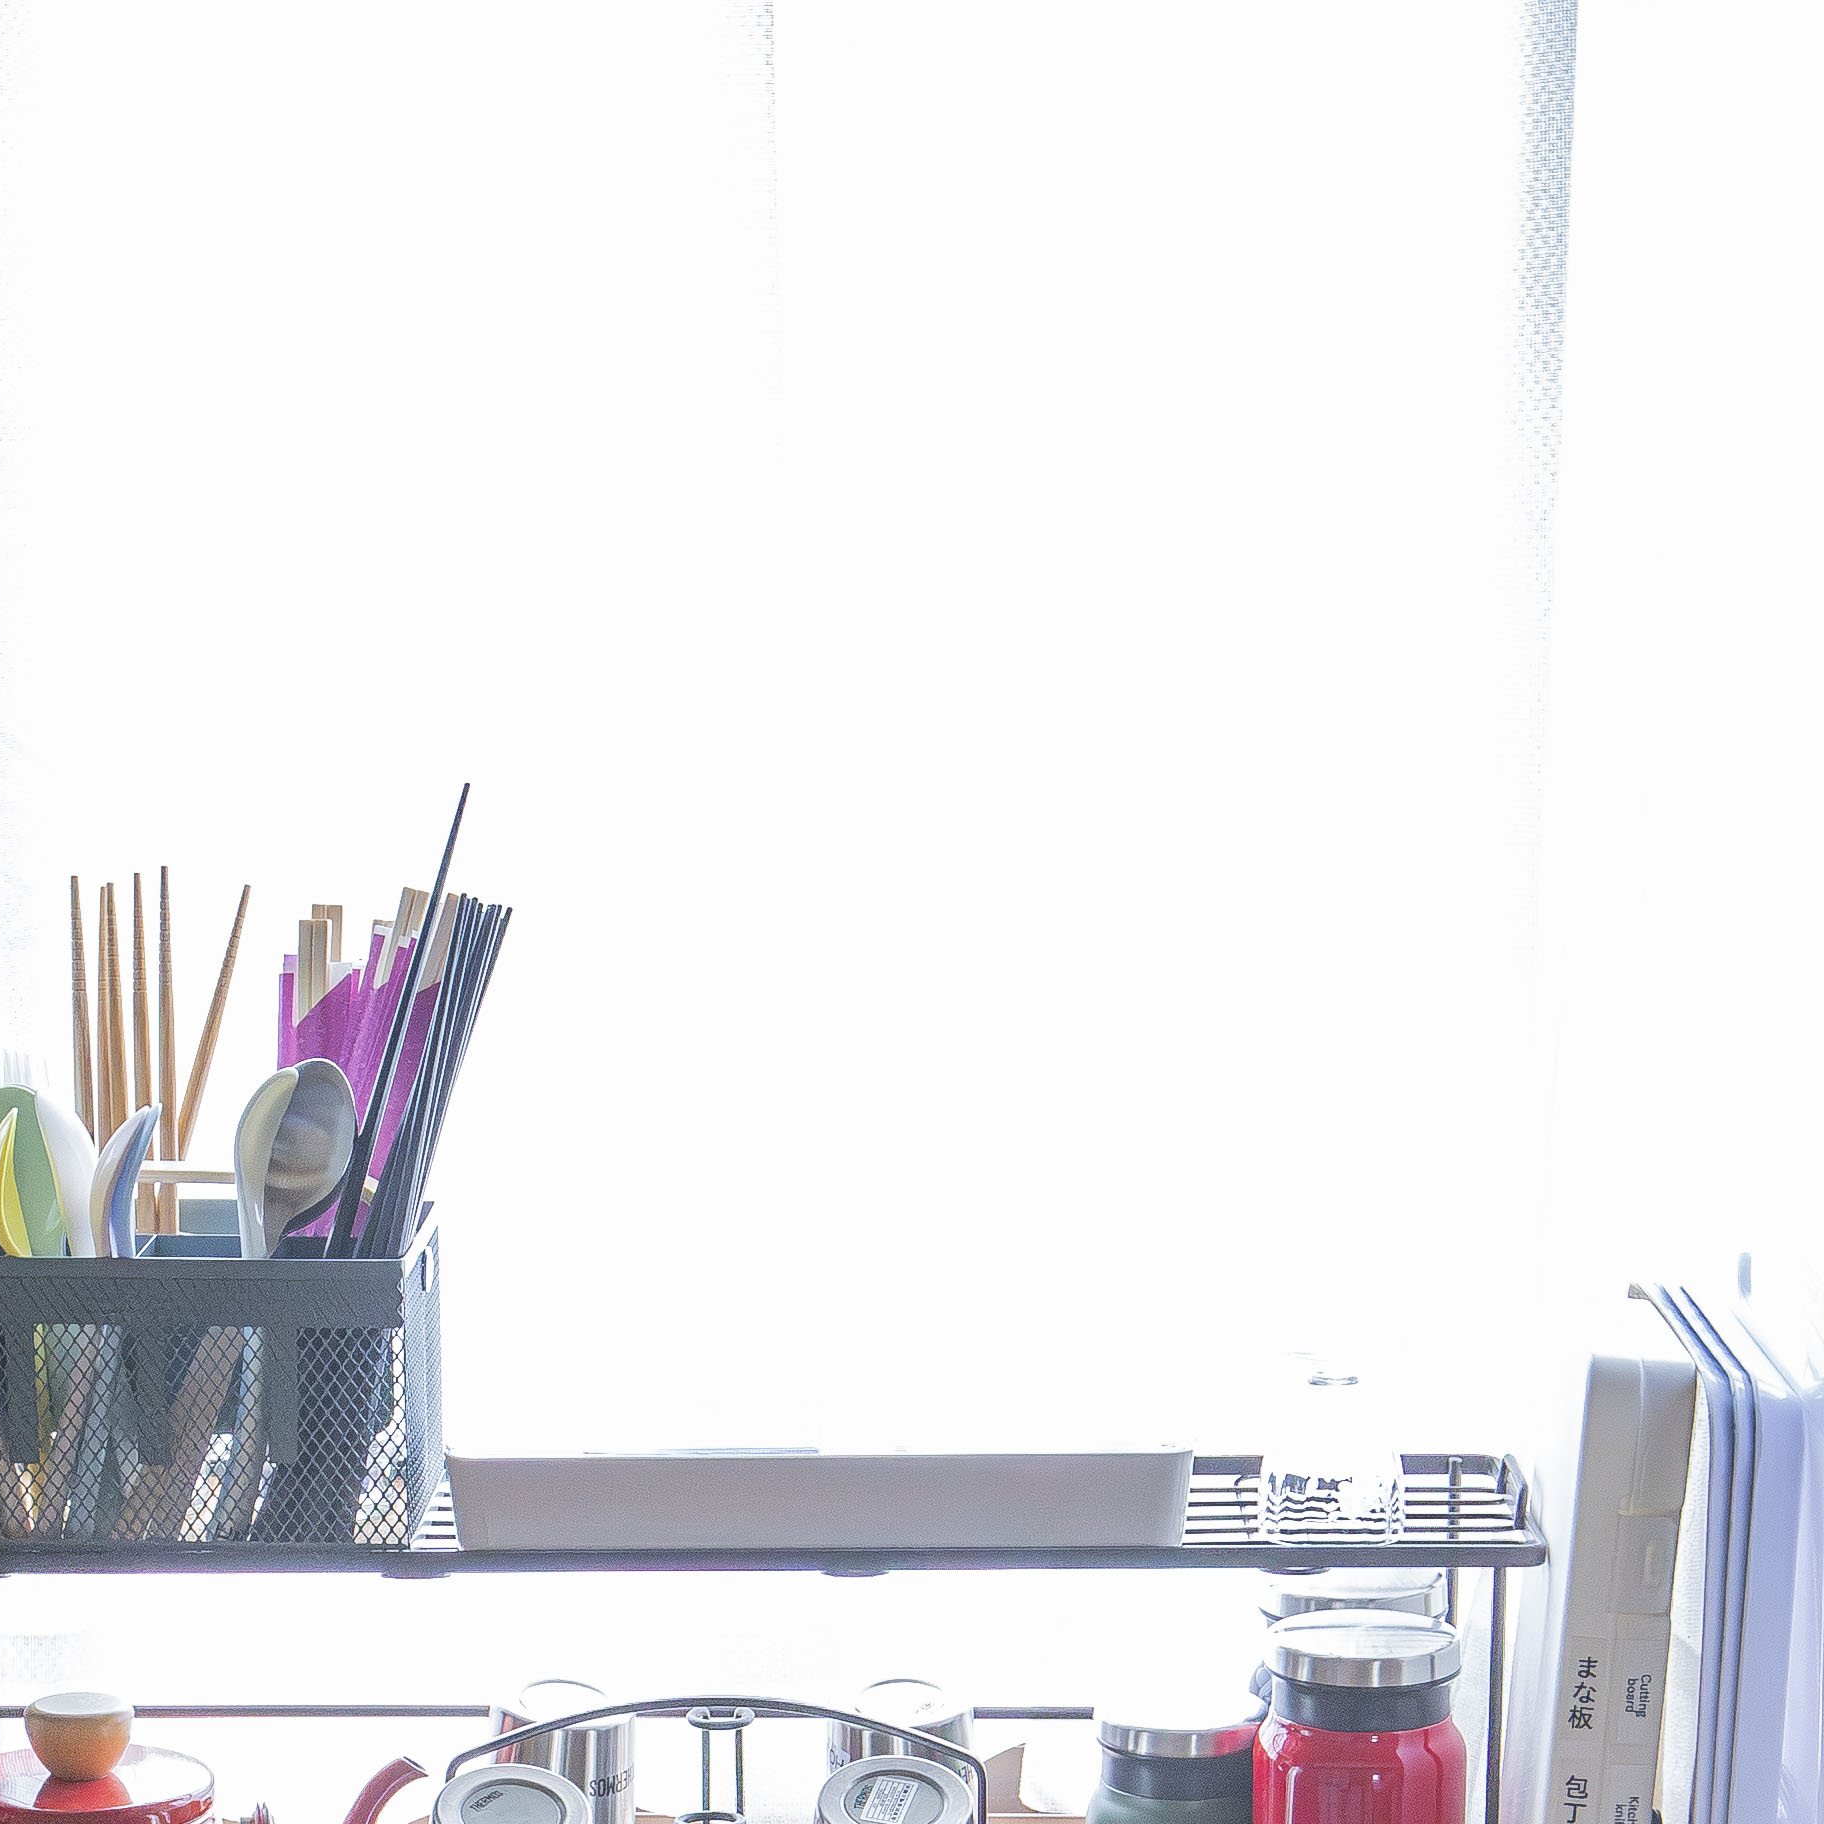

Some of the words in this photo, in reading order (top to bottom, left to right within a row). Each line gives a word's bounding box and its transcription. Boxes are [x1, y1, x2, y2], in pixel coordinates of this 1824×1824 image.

[1568, 1657, 1599, 1730] まな板
[1625, 1678, 1639, 1713] board
[1635, 1674, 1653, 1718] Cutting
[1563, 1775, 1589, 1823] 包丁
